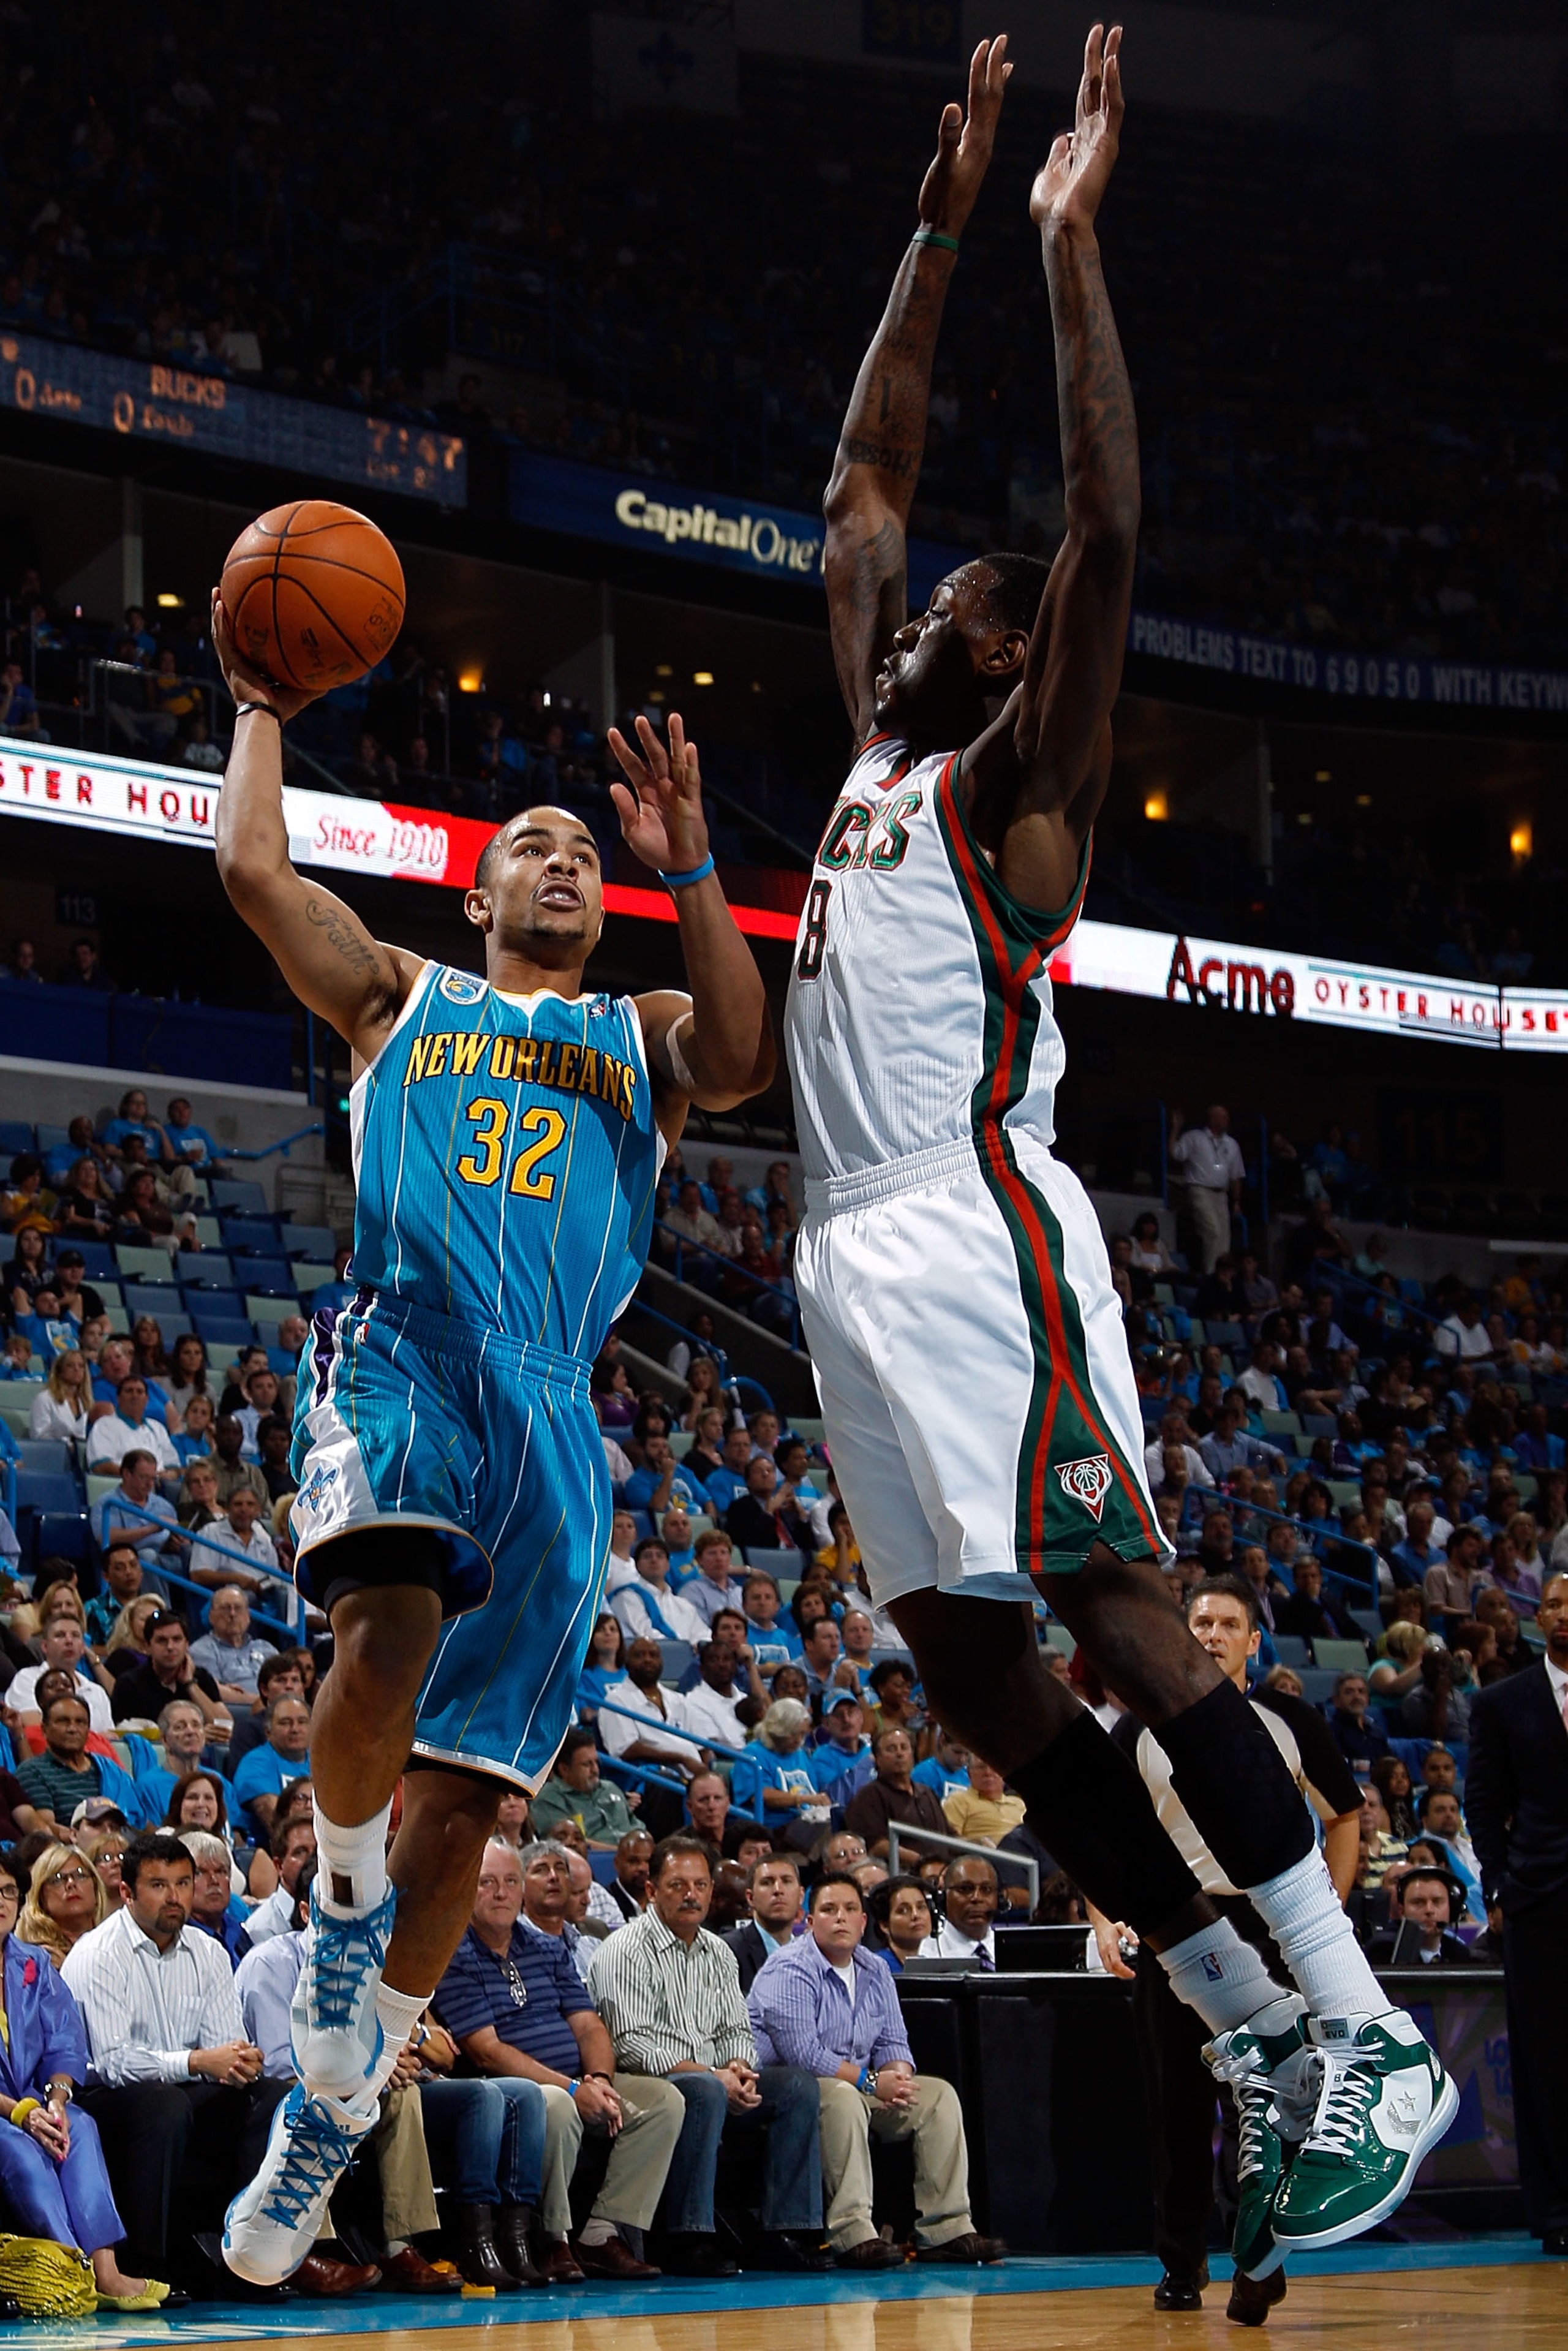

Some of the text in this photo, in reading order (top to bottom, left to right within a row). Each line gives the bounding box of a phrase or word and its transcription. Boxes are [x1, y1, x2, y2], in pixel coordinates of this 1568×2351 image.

[151, 363, 227, 411] BUCKS
[1133, 614, 1235, 671] PROBLEMS
[1238, 637, 1286, 681] TEXT
[1292, 649, 1317, 688] TO
[1431, 666, 1492, 705] WITH
[127, 784, 208, 825] HOU
[313, 815, 377, 856] Since
[386, 823, 445, 867] 1910
[59, 894, 96, 923] 113
[799, 878, 832, 982] 8
[1167, 934, 1295, 1017] Acme
[1314, 978, 1428, 1020] OYSTER
[402, 1032, 637, 1122] NEW ORLEANS
[456, 1096, 568, 1202] 32
[1394, 1108, 1487, 1164] 115
